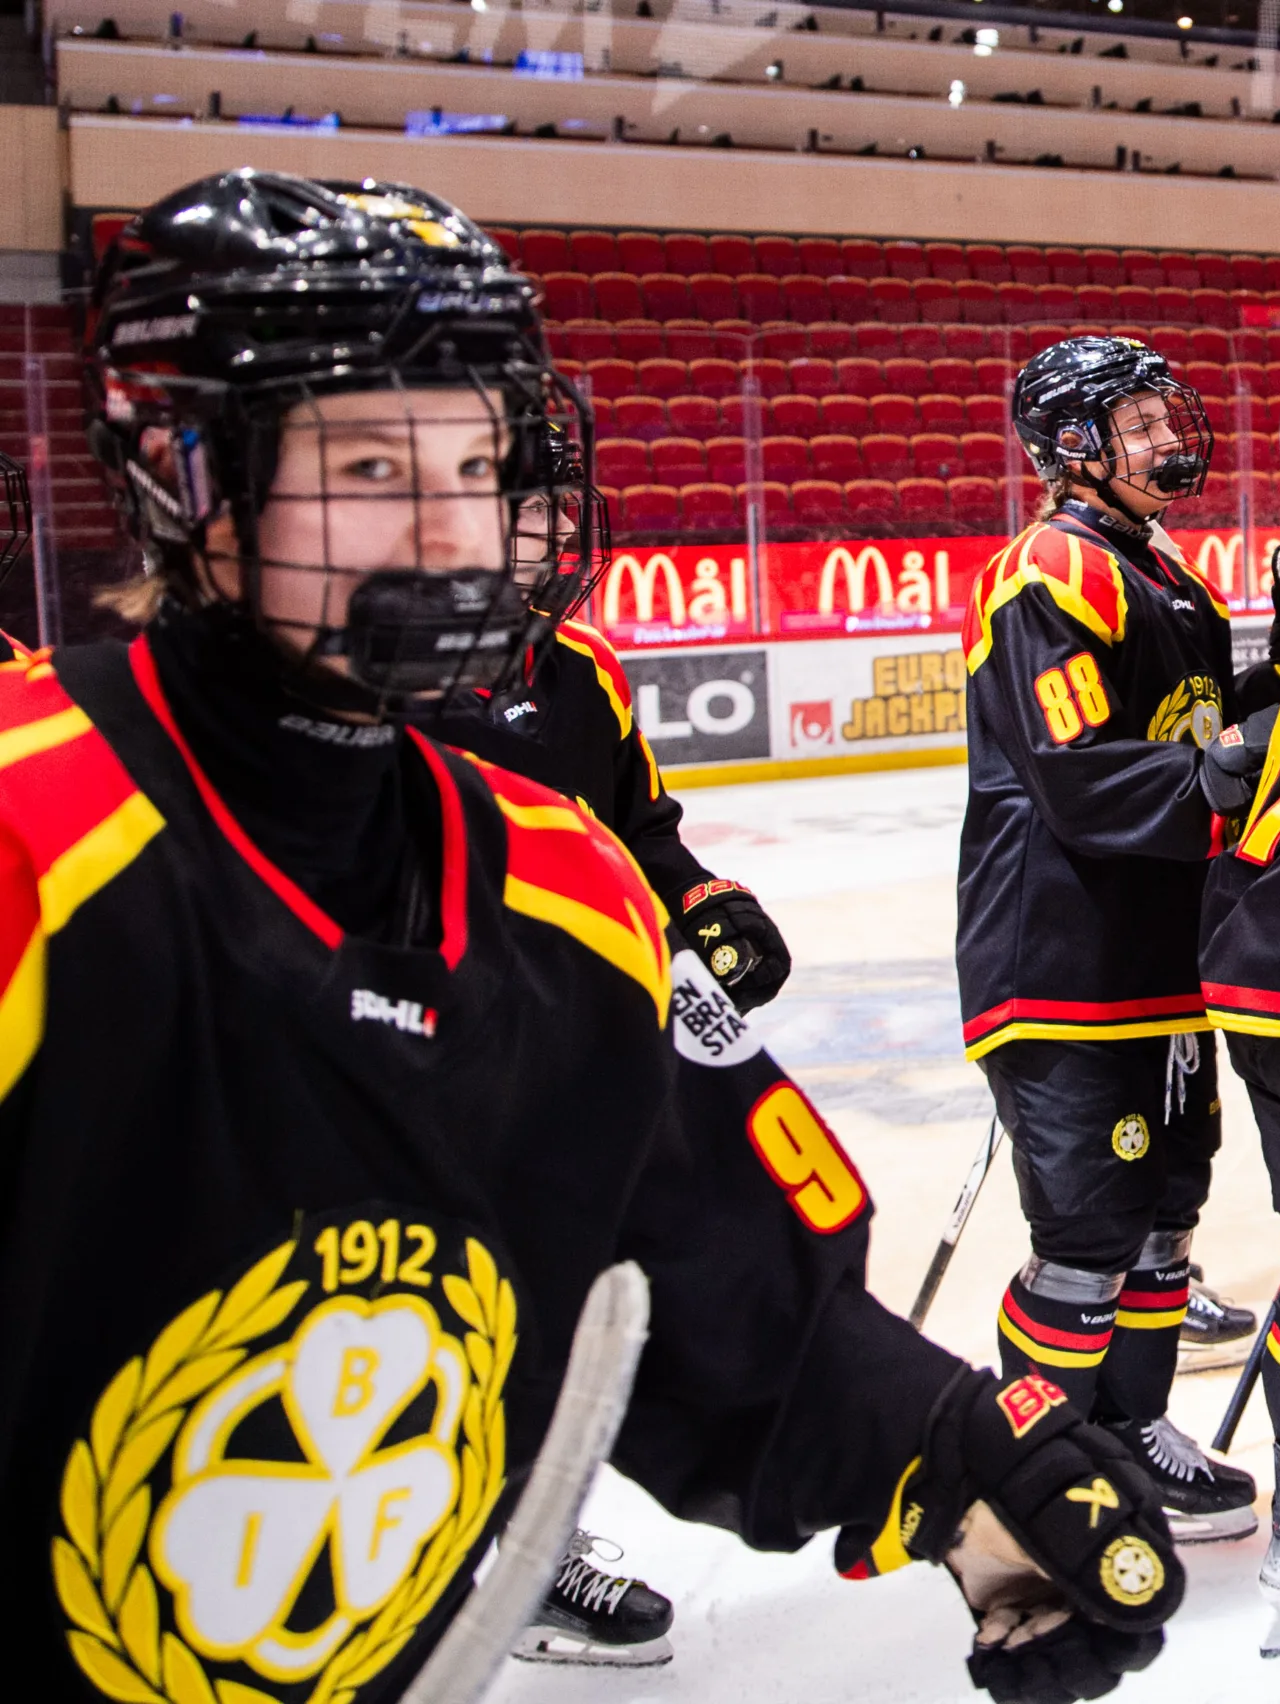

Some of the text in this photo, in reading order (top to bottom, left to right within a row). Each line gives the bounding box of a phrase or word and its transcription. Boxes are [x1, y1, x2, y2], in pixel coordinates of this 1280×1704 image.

[1038, 380, 1077, 404] BAUER
[604, 553, 748, 627] Mål
[819, 546, 950, 619] Mål
[1034, 651, 1111, 745] 88
[682, 991, 731, 1038] BRA
[746, 1080, 868, 1236] 9
[313, 1220, 437, 1291] 1912
[332, 1344, 380, 1418] B
[235, 1486, 411, 1588] I F
